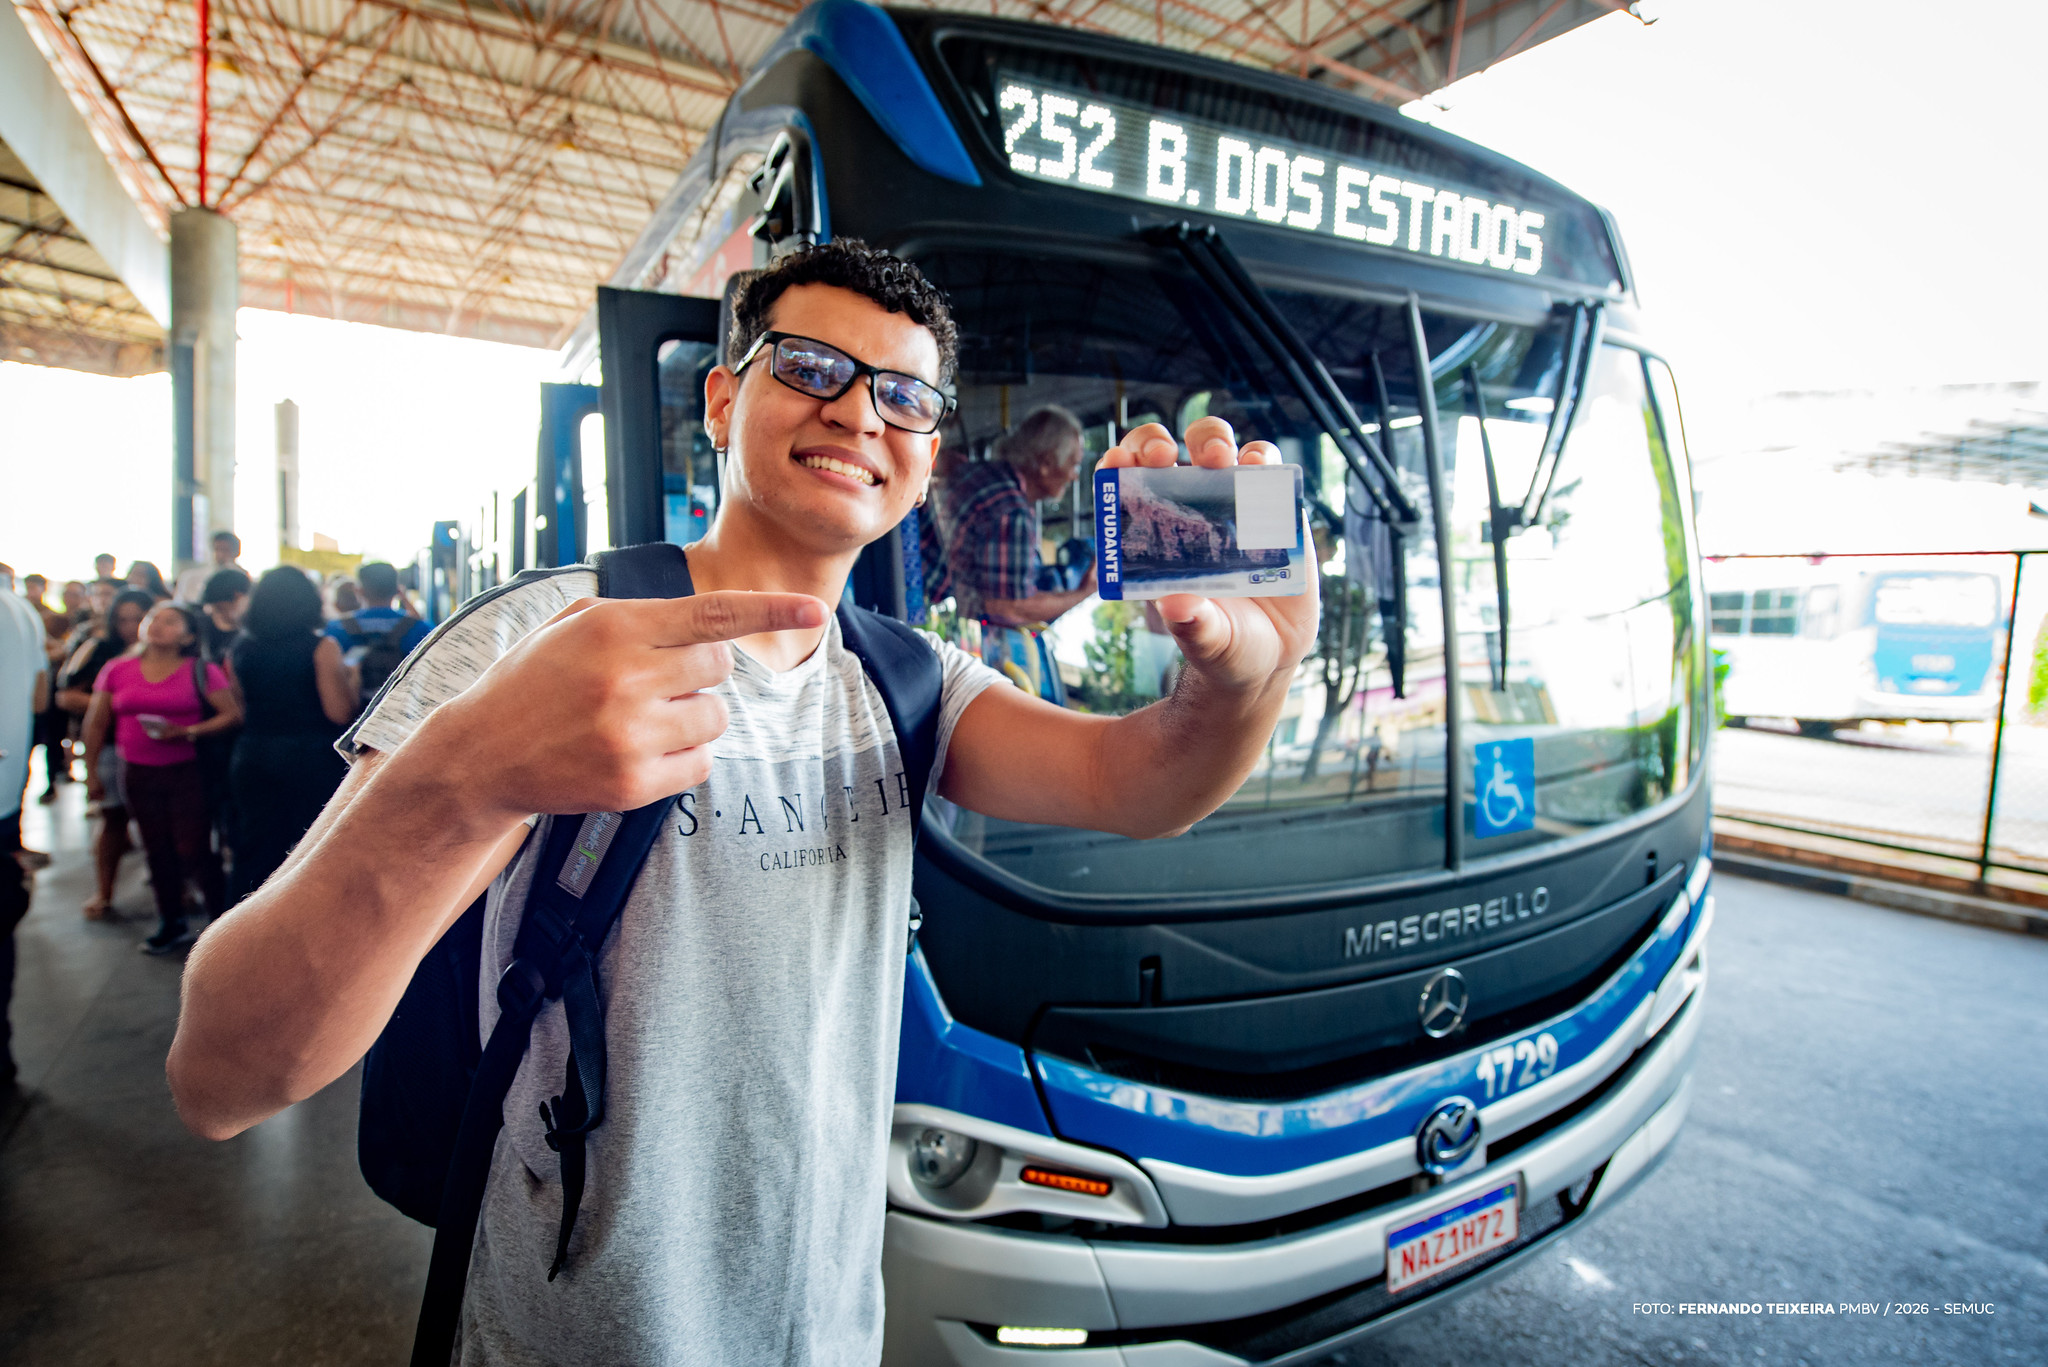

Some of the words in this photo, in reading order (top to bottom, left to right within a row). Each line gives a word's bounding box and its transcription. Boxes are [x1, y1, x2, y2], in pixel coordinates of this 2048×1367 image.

[1000, 85, 1116, 188] 252
[1147, 119, 1200, 206] B.
[1215, 136, 1325, 230] DOS
[1333, 165, 1545, 276] ESTADOS
[1102, 482, 1119, 583] ESTUDANTE
[1344, 886, 1550, 958] MASCARELLO
[1476, 1032, 1559, 1099] 1729
[1401, 1208, 1505, 1279] NAZ1H72
